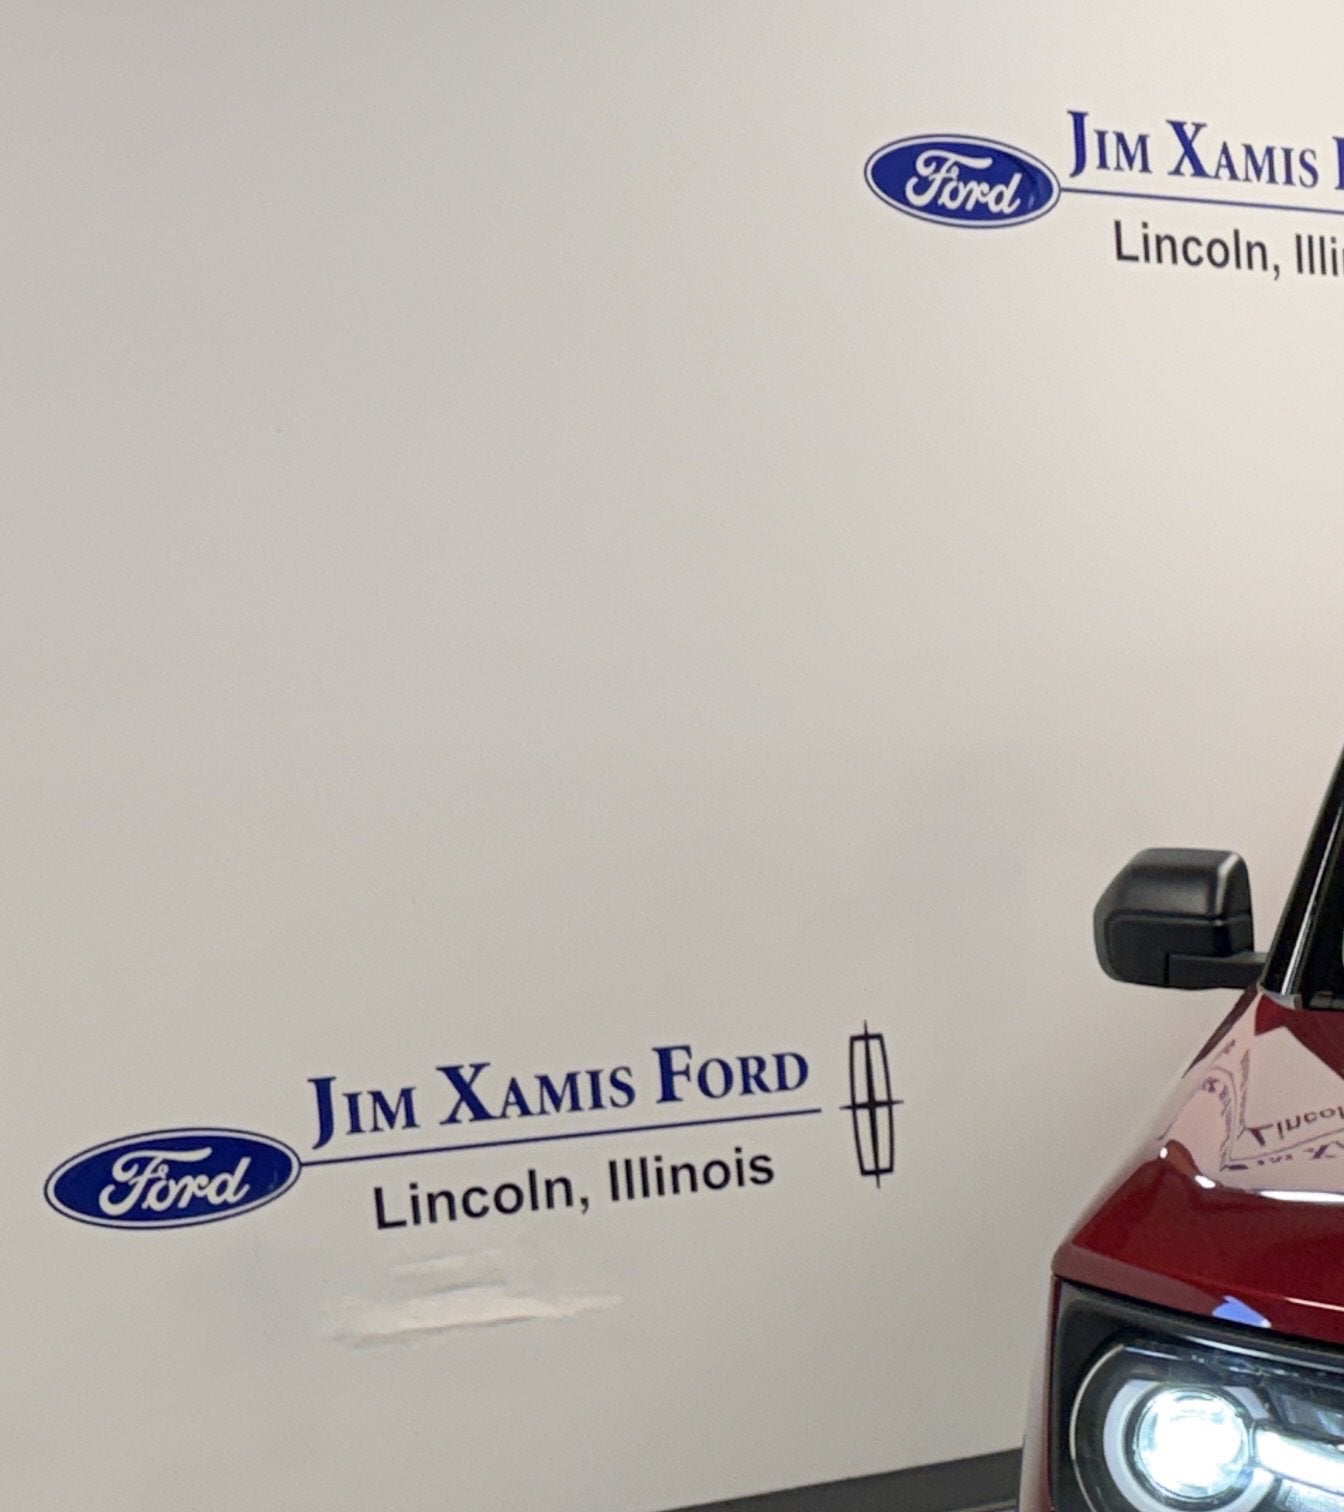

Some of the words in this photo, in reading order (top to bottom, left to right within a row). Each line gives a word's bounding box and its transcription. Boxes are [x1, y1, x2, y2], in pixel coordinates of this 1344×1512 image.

[906, 149, 1021, 214] Ford
[1067, 110, 1152, 178] JIM
[1166, 120, 1318, 188] XAMIS
[1114, 220, 1279, 280] Lincoln,
[307, 1076, 420, 1150] JIM
[436, 1063, 635, 1125] XAMIS
[652, 1045, 808, 1104] FORD
[98, 1147, 252, 1216] Ford
[374, 1169, 589, 1230] Lincoln,
[609, 1147, 774, 1201] Illinois
